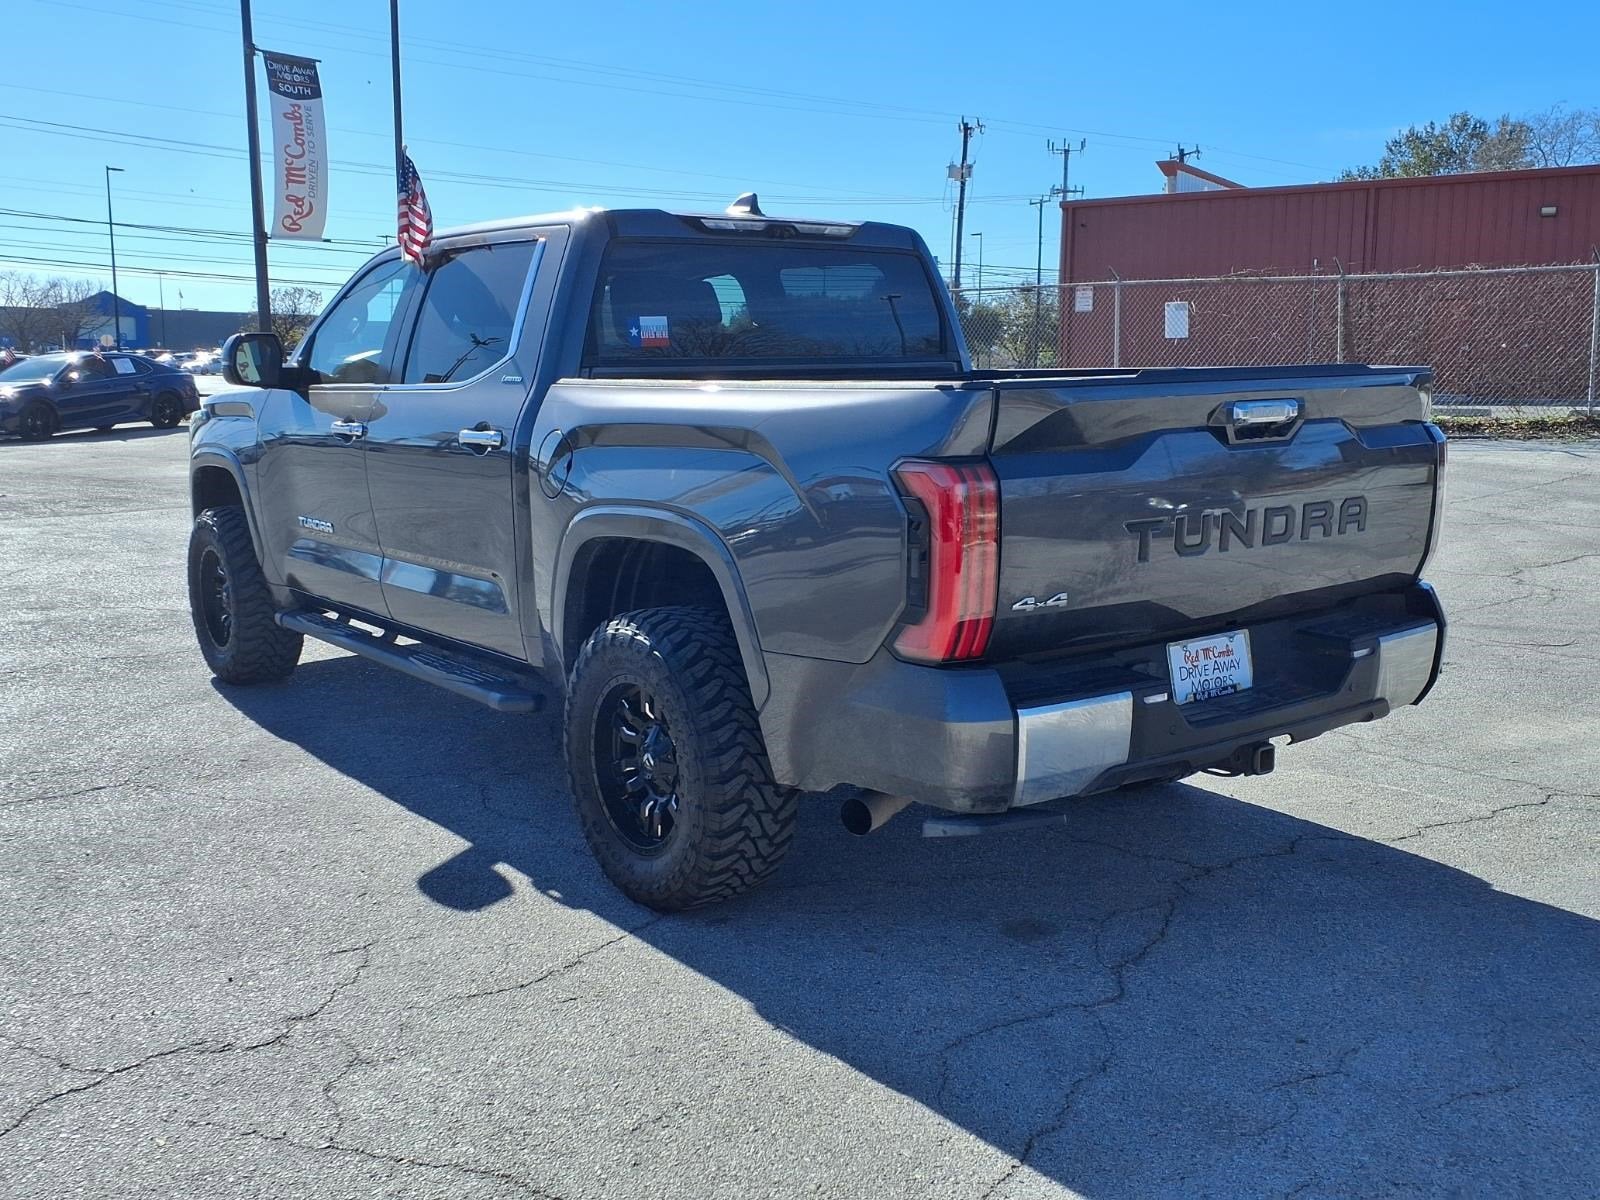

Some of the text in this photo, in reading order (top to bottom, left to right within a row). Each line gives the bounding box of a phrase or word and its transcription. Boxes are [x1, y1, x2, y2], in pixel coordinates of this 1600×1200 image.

[267, 60, 315, 77] DRIVE AWAY
[276, 71, 311, 84] MOTORS
[278, 82, 312, 96] SOUTH
[304, 105, 317, 199] DRIVEN TO SERVE
[281, 103, 314, 233] Red McCombs
[297, 515, 334, 534] TUNDRA
[1123, 495, 1368, 563] TUNDRA
[1183, 644, 1234, 668] Red McCombs
[1179, 657, 1241, 682] DRIVE AWAY
[1191, 675, 1234, 692] MOTORS
